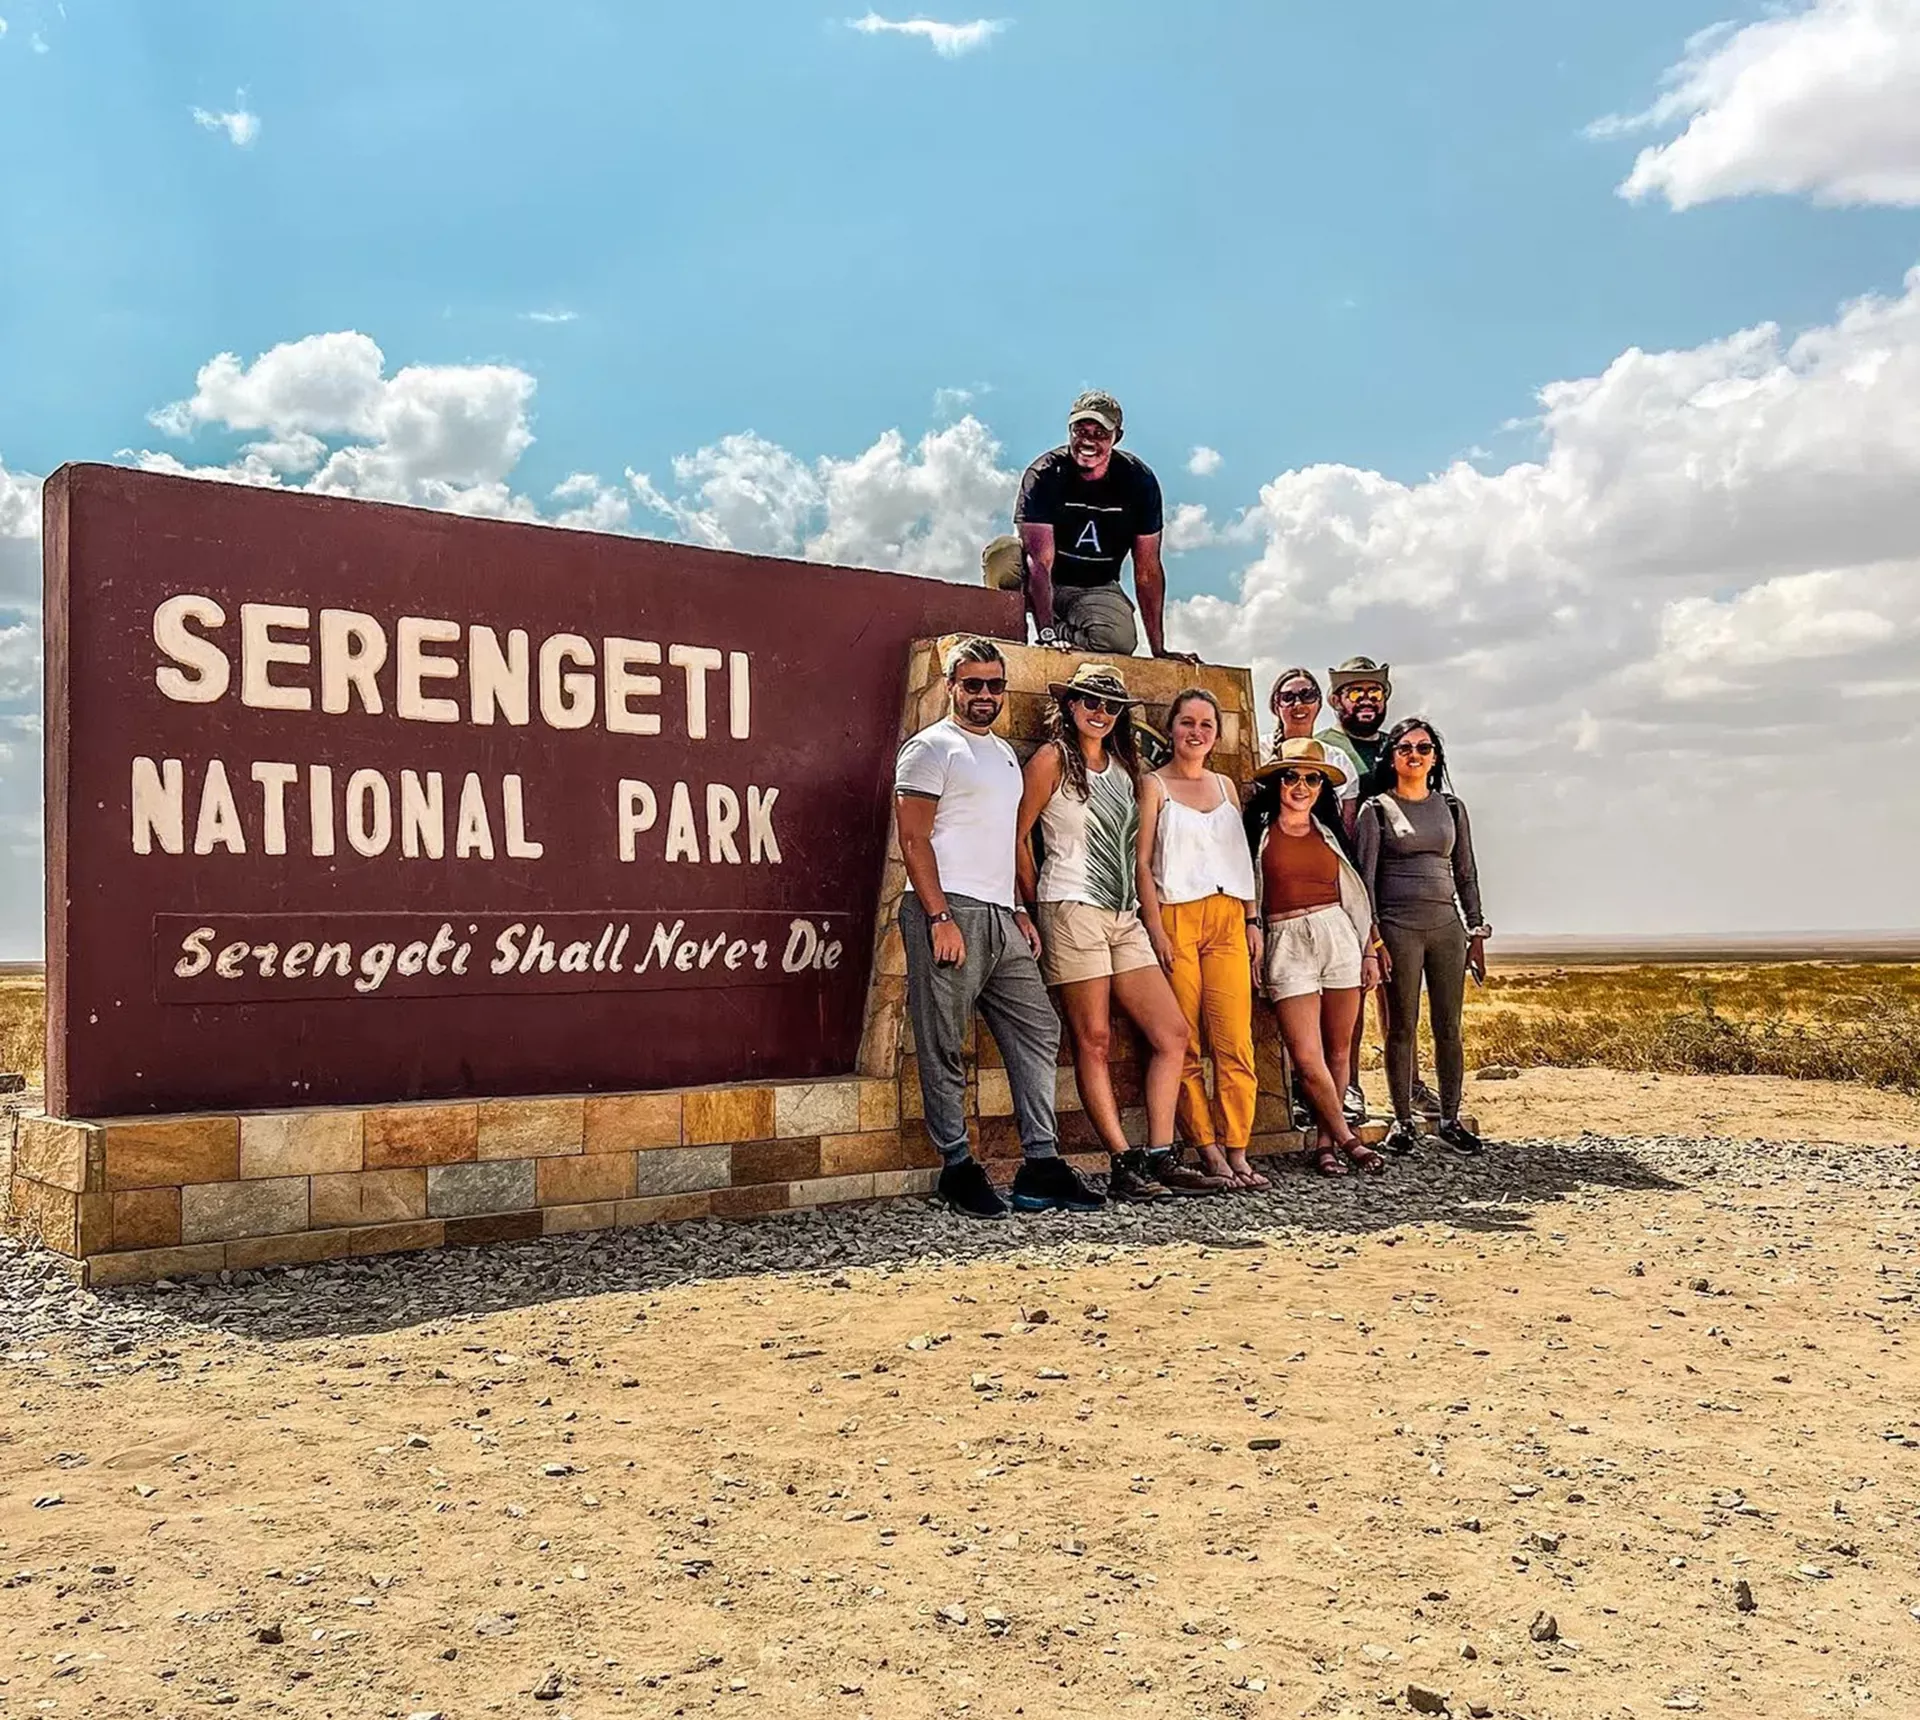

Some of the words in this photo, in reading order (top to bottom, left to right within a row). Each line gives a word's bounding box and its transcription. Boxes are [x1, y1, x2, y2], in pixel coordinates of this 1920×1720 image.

[151, 593, 751, 741] SERENGETI
[130, 755, 545, 861] NATIONAL
[617, 777, 784, 866] PARK
[489, 921, 631, 976] Shall
[633, 918, 769, 975] Never
[780, 917, 843, 974] Die
